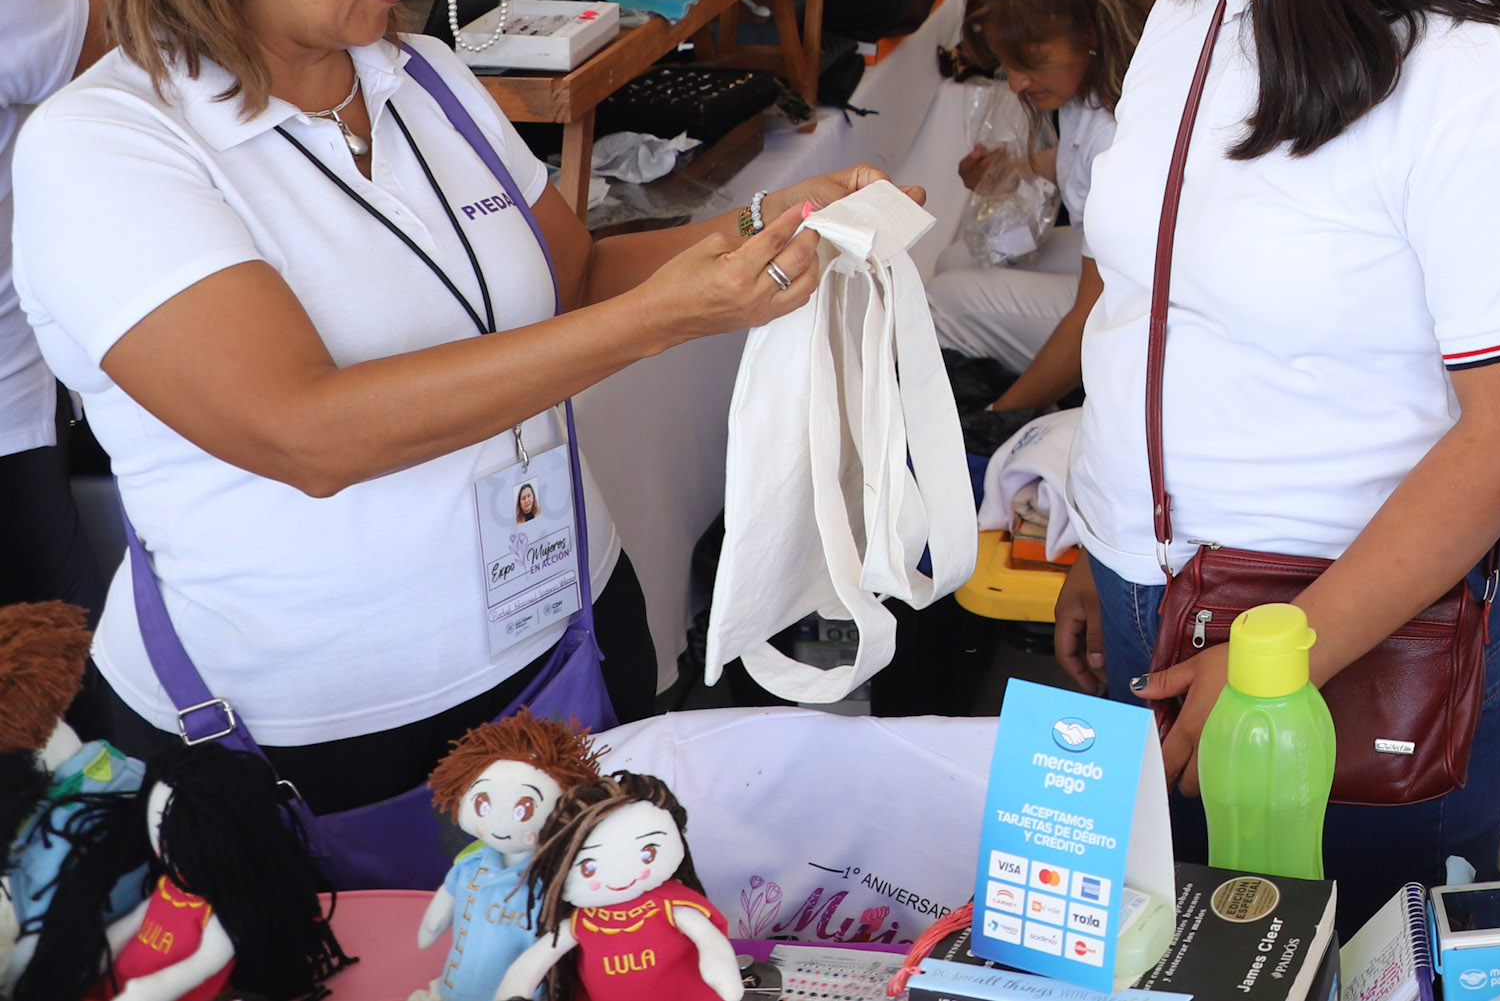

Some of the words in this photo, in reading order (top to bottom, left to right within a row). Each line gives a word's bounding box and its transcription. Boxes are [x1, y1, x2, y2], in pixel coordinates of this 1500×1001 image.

[527, 537, 567, 564] Mujeres
[491, 562, 516, 583] Expo
[530, 565, 540, 575] EN
[1032, 752, 1103, 780] mercado
[1044, 772, 1085, 794] pago
[996, 810, 1052, 834] TARJETAS
[1054, 825, 1071, 839] DE
[1072, 826, 1117, 850] DÉBITO
[1021, 803, 1094, 830] ACEPTAMOS
[1023, 830, 1033, 842] Y
[1033, 829, 1085, 855] CRÉDITO
[997, 859, 1021, 875] VISA
[1182, 892, 1202, 918] buenos
[1226, 881, 1250, 915] EDICIÓN
[1235, 880, 1262, 920] ESPECIAL
[1164, 944, 1189, 977] desterrar
[1182, 931, 1195, 943] los
[1191, 908, 1207, 931] malos
[1236, 954, 1267, 993] James
[1258, 916, 1284, 952] Clear
[603, 949, 656, 976] LULA
[1274, 937, 1300, 978] PAIDÓS
[1002, 976, 1054, 998] things
